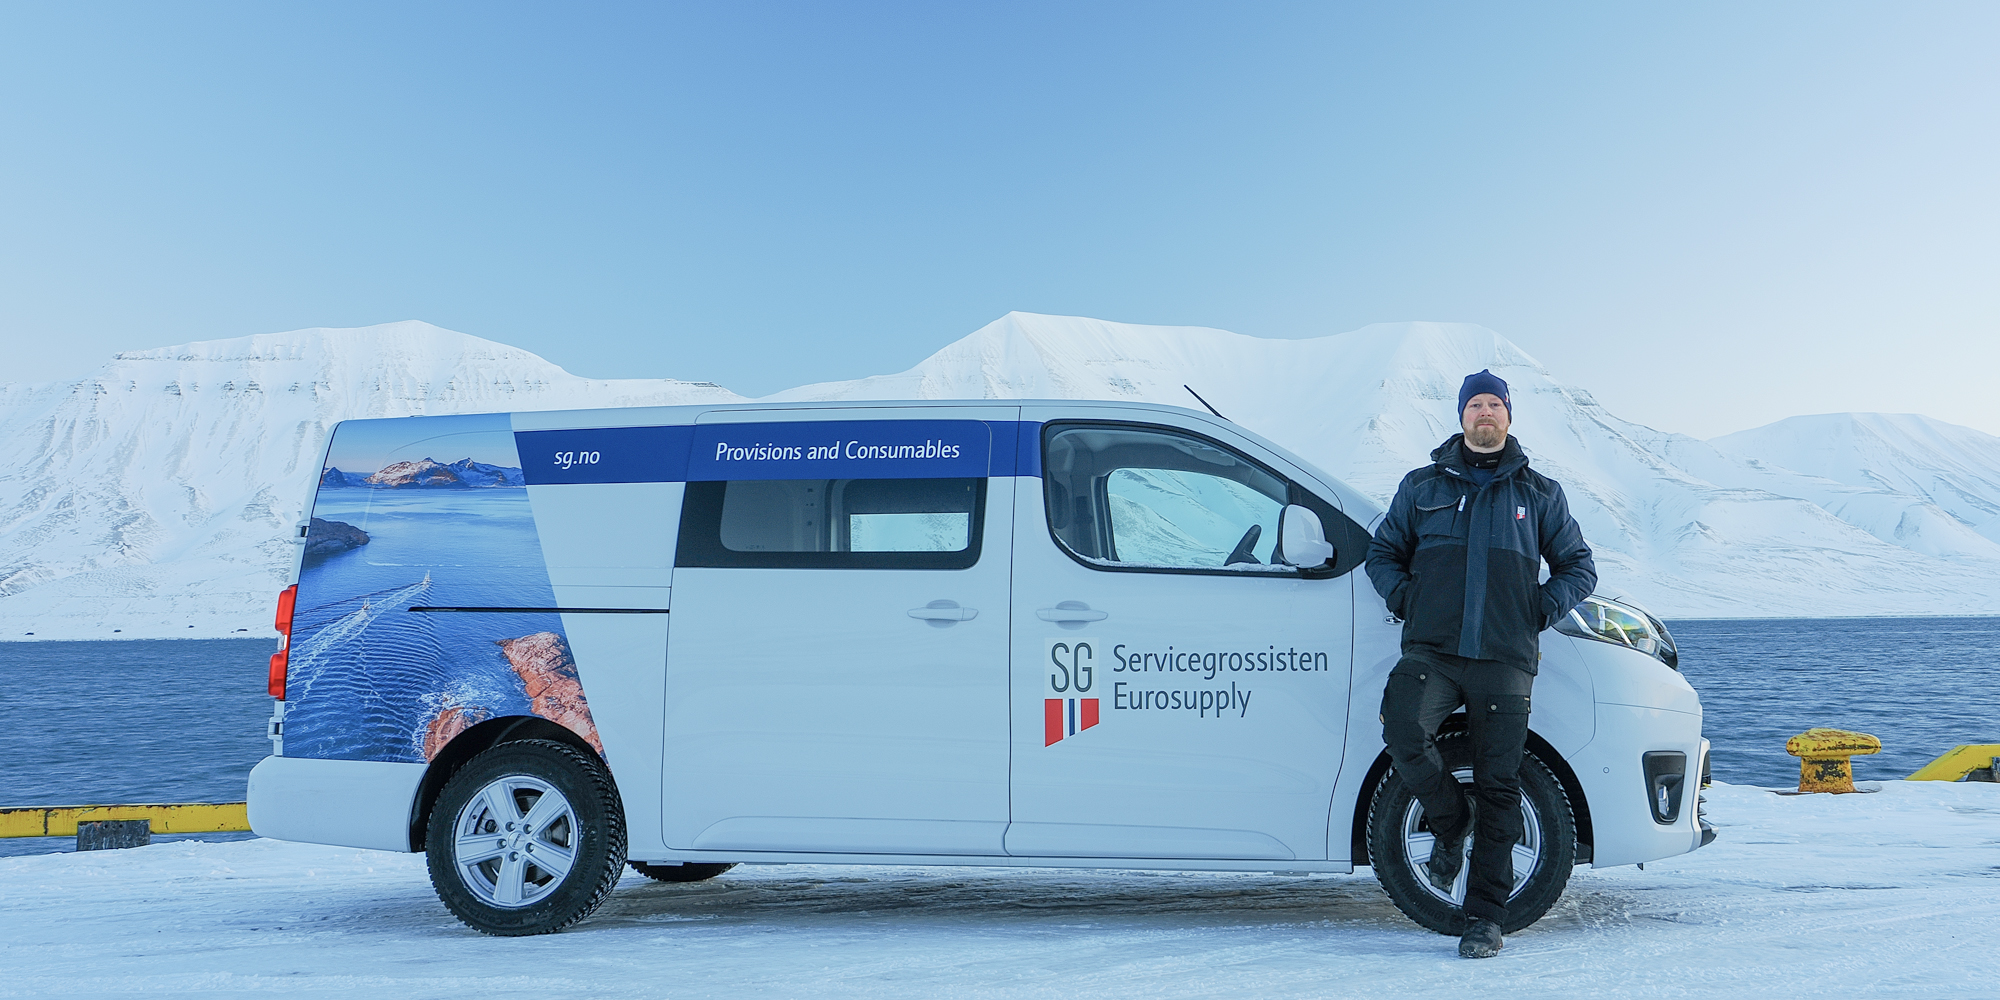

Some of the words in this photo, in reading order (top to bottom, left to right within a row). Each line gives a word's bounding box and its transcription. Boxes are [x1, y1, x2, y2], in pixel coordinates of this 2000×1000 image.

[553, 448, 601, 469] sg.no
[715, 441, 802, 461] Provisions
[806, 441, 840, 460] and
[845, 440, 960, 460] Consumables
[1051, 642, 1093, 693] SG
[1113, 644, 1329, 680] Servicegrossisten
[1114, 681, 1252, 718] Eurosupply
